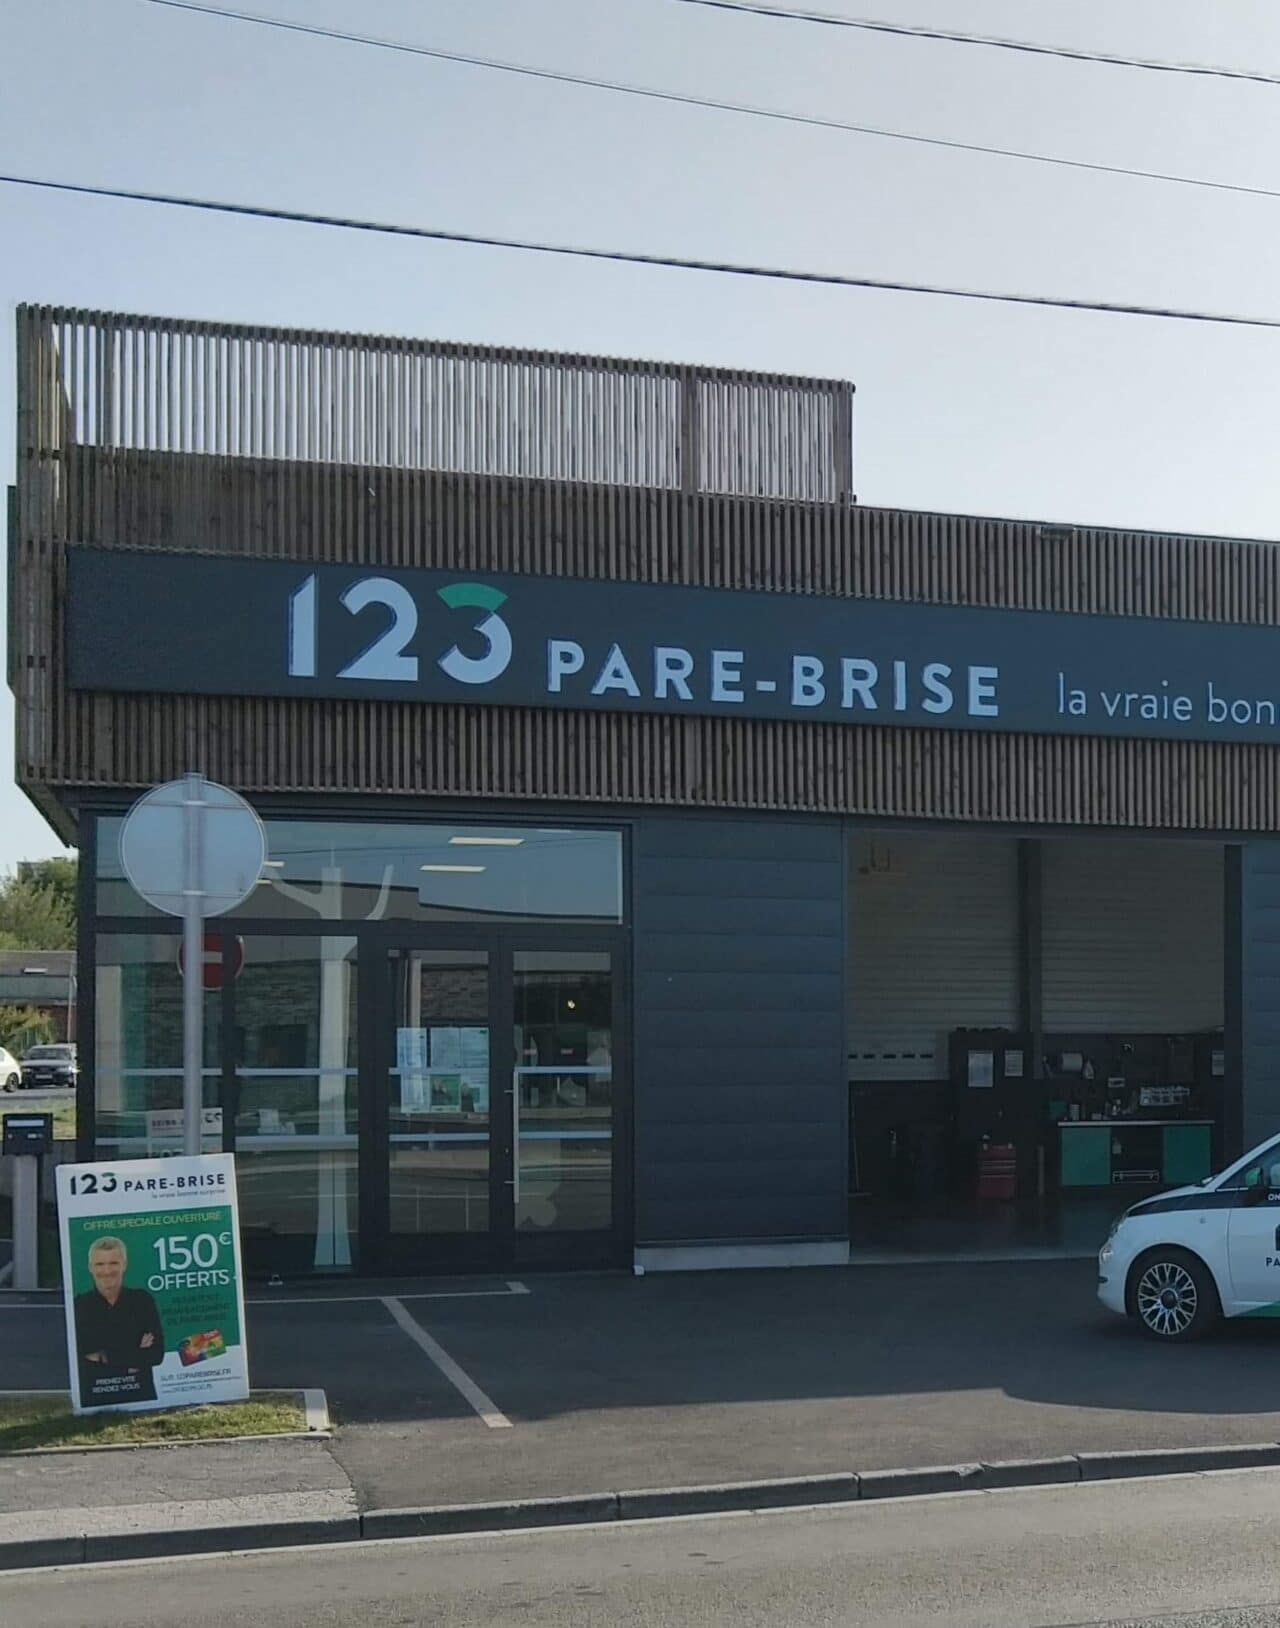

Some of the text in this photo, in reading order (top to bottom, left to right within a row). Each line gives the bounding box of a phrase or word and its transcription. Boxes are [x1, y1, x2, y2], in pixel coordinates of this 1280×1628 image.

[288, 571, 513, 684] 123
[547, 639, 999, 717] PARE-BRISE
[1058, 672, 1087, 716] la
[1100, 680, 1193, 721] vraie
[70, 1172, 226, 1196] 123 PARE-BRISE
[1267, 1193, 1280, 1201] ON
[153, 1231, 232, 1271] 150€
[148, 1269, 230, 1291] OFFERTS
